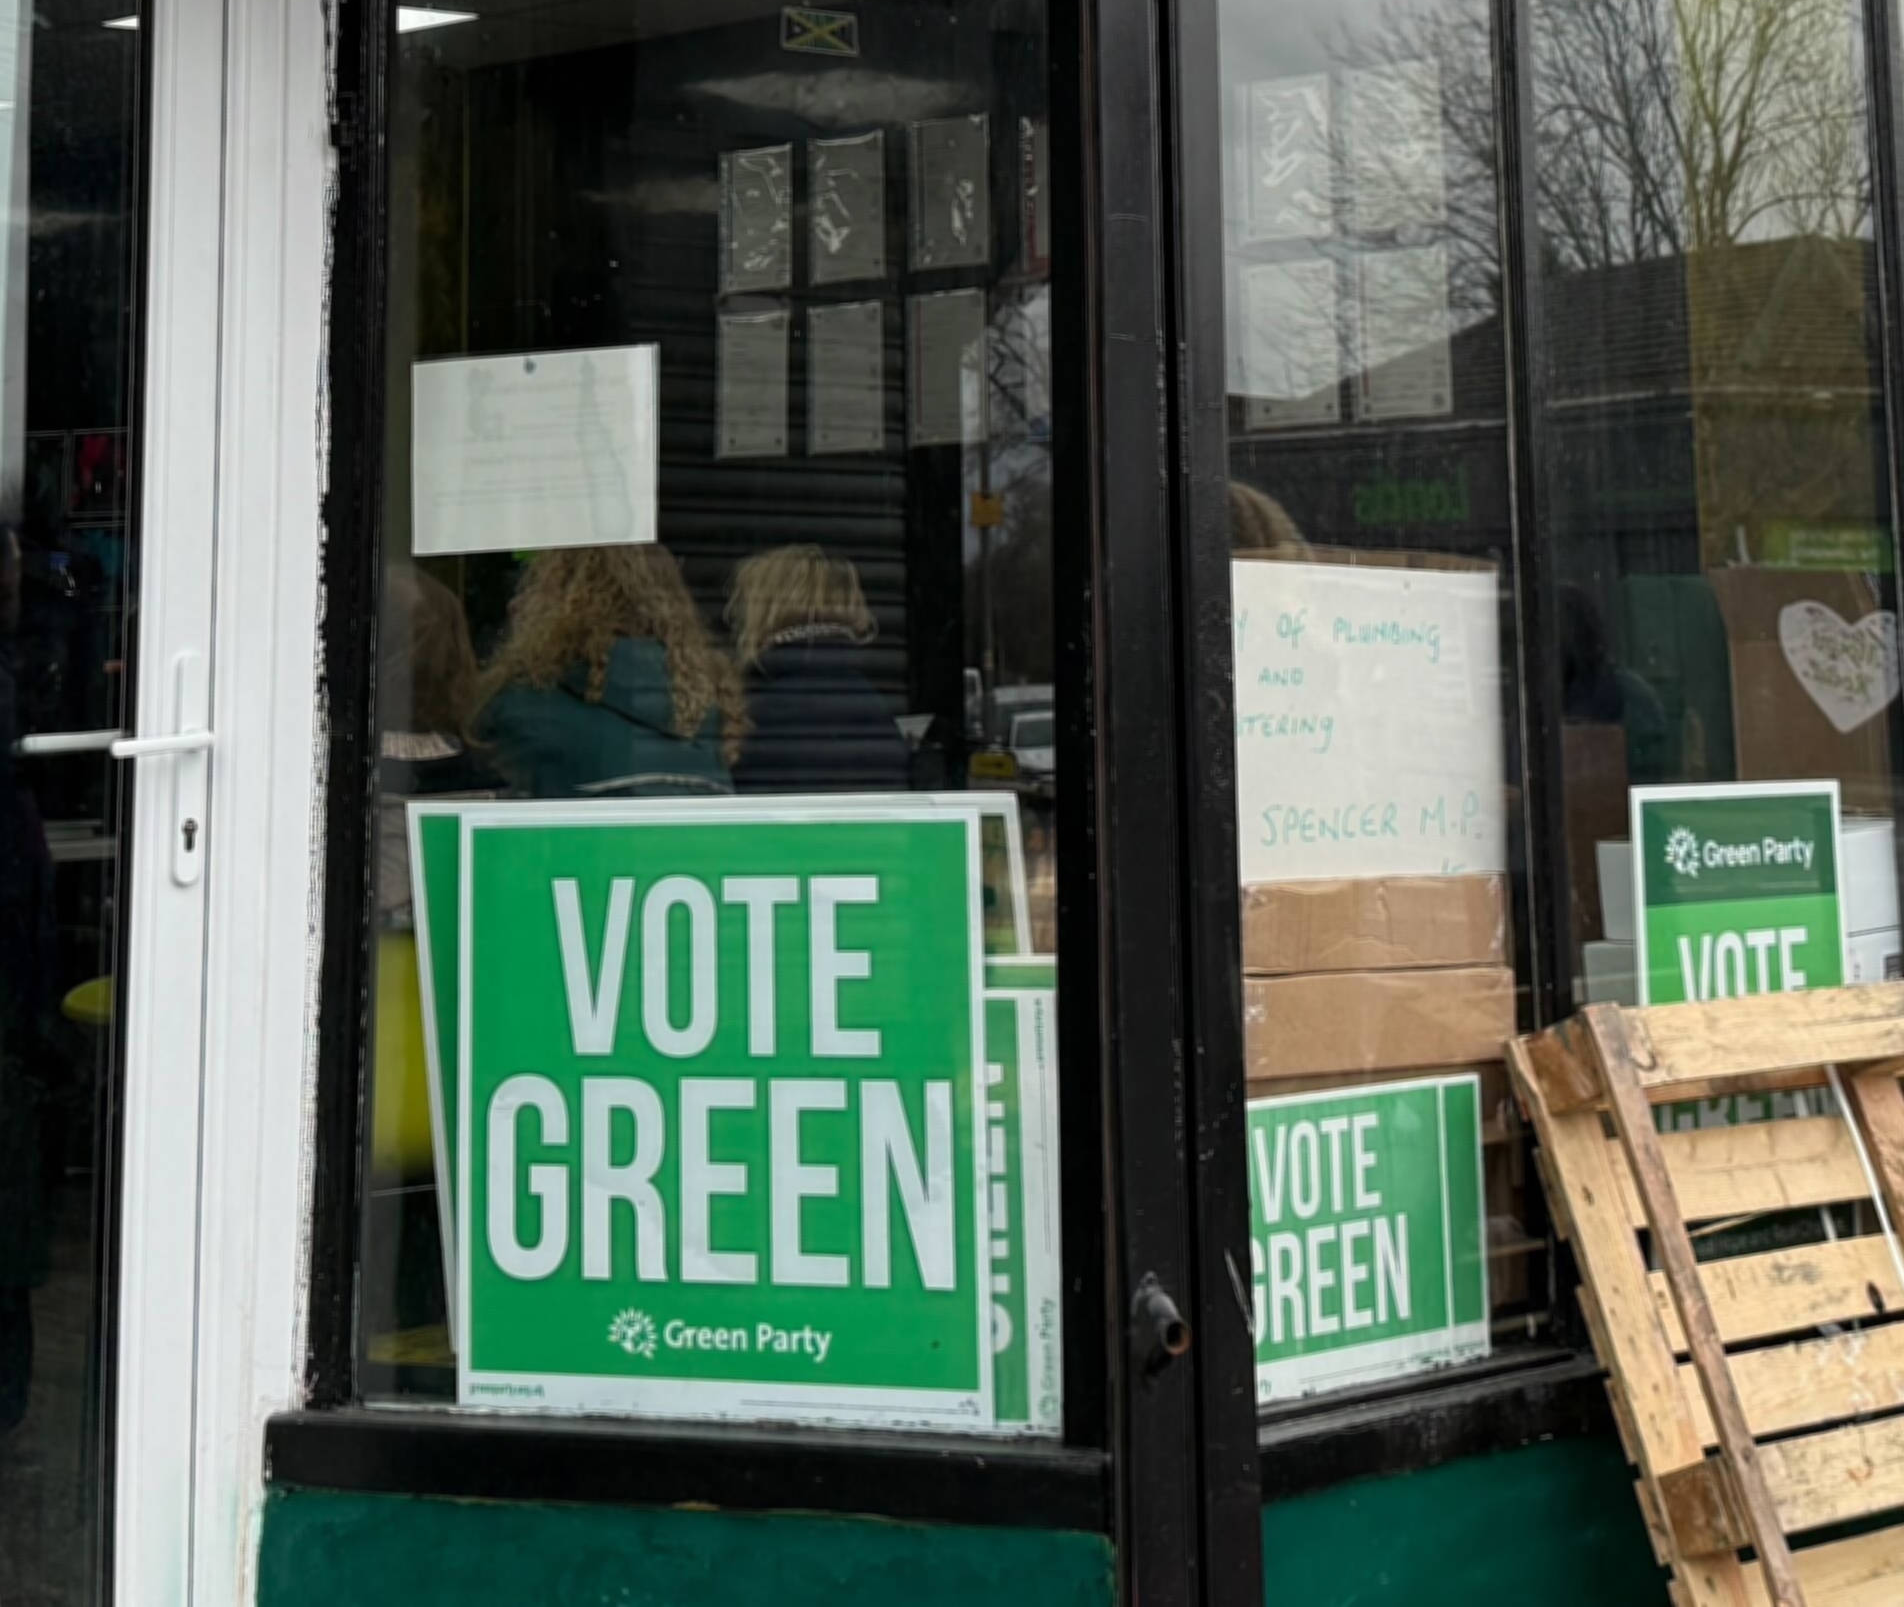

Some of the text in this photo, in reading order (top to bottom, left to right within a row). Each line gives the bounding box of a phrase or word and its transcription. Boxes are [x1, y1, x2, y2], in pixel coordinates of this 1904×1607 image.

[1257, 666, 1305, 687] AND
[1260, 802, 1398, 847] SPENCER
[1702, 835, 1815, 871] Green Party
[550, 874, 883, 1058] VOTE
[1676, 925, 1809, 1003] VOTE
[485, 1072, 958, 1292] GREEN
[1254, 1111, 1383, 1225] VOTE
[663, 1318, 833, 1364] Green Party
